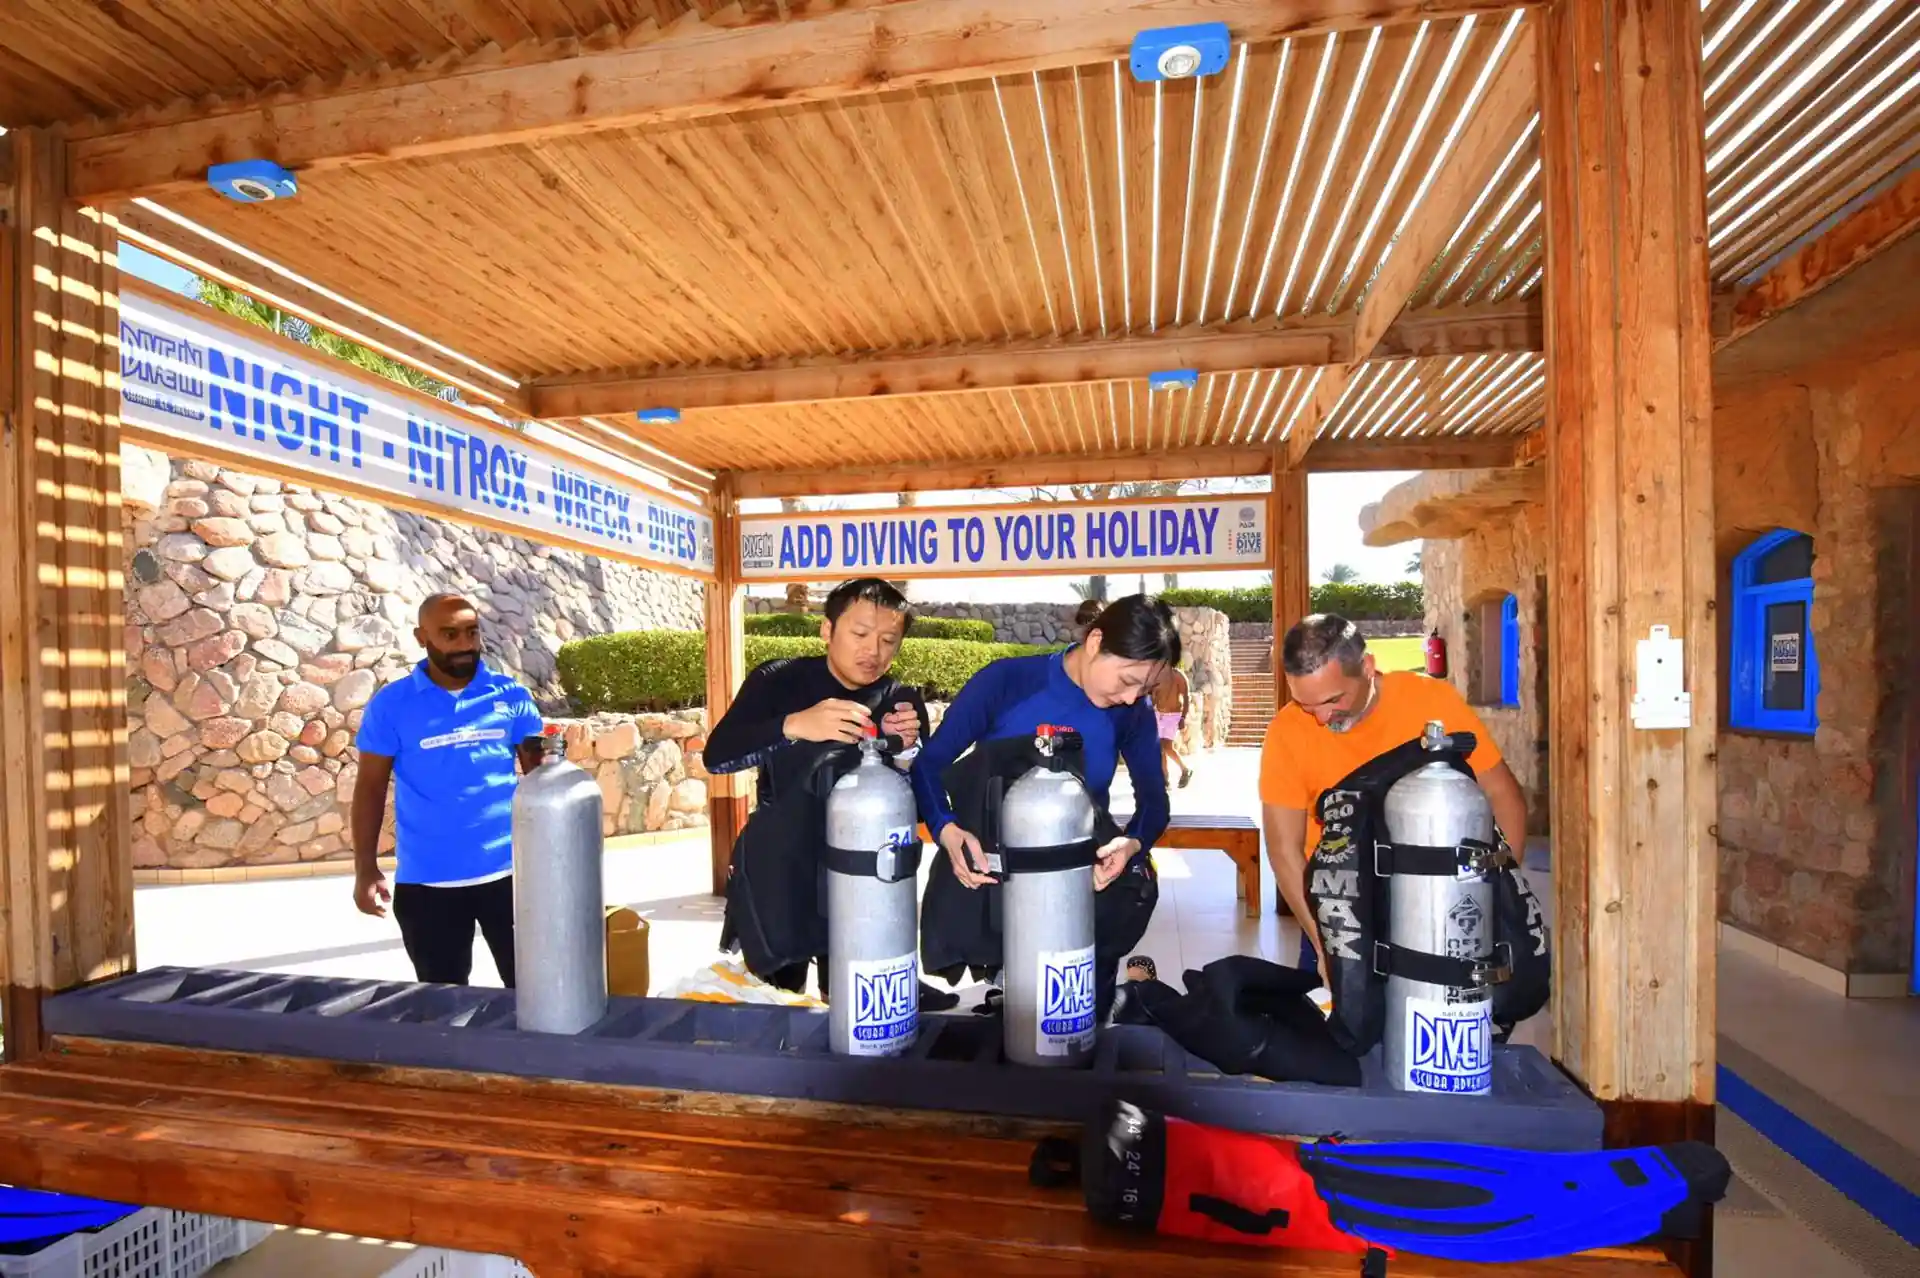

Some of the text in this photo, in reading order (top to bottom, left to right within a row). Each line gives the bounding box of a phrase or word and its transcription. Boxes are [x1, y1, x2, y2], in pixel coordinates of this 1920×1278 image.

[208, 347, 369, 469] NIGHT
[407, 412, 530, 515] NITROX
[551, 464, 633, 544] WRECK
[647, 501, 697, 562] DIVES
[779, 507, 1220, 569] ADD DIVING TO YOUR HOLIDAY
[1236, 539, 1261, 549] DIVE
[855, 968, 909, 1022] DIVE
[1413, 1010, 1478, 1071] DIVE
[1415, 1069, 1448, 1090] SCUBA
